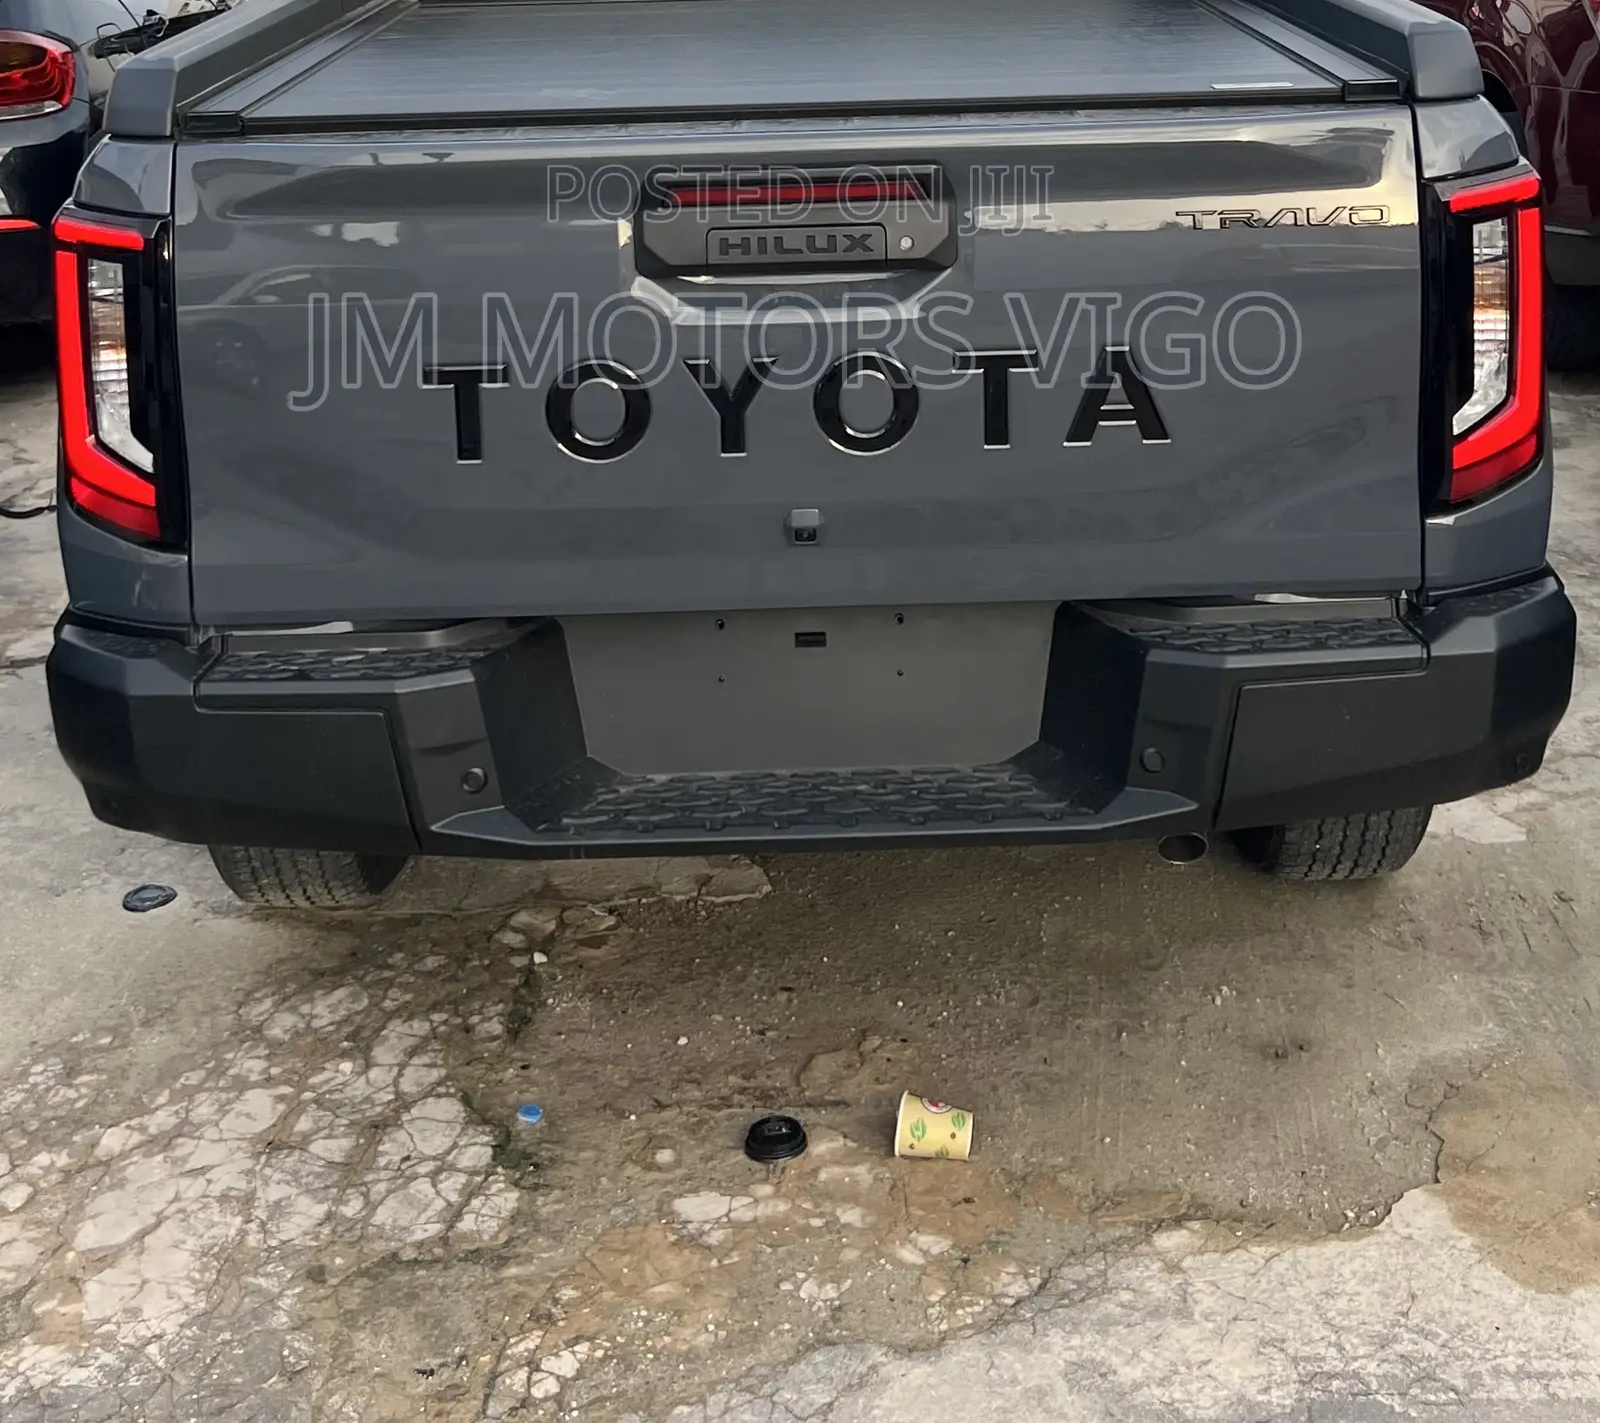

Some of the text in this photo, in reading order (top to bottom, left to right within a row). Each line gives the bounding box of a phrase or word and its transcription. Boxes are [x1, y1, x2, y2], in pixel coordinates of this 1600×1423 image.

[1175, 205, 1391, 230] TRAVO
[718, 233, 875, 257] HILUX
[421, 345, 1172, 464] TOYOTA
